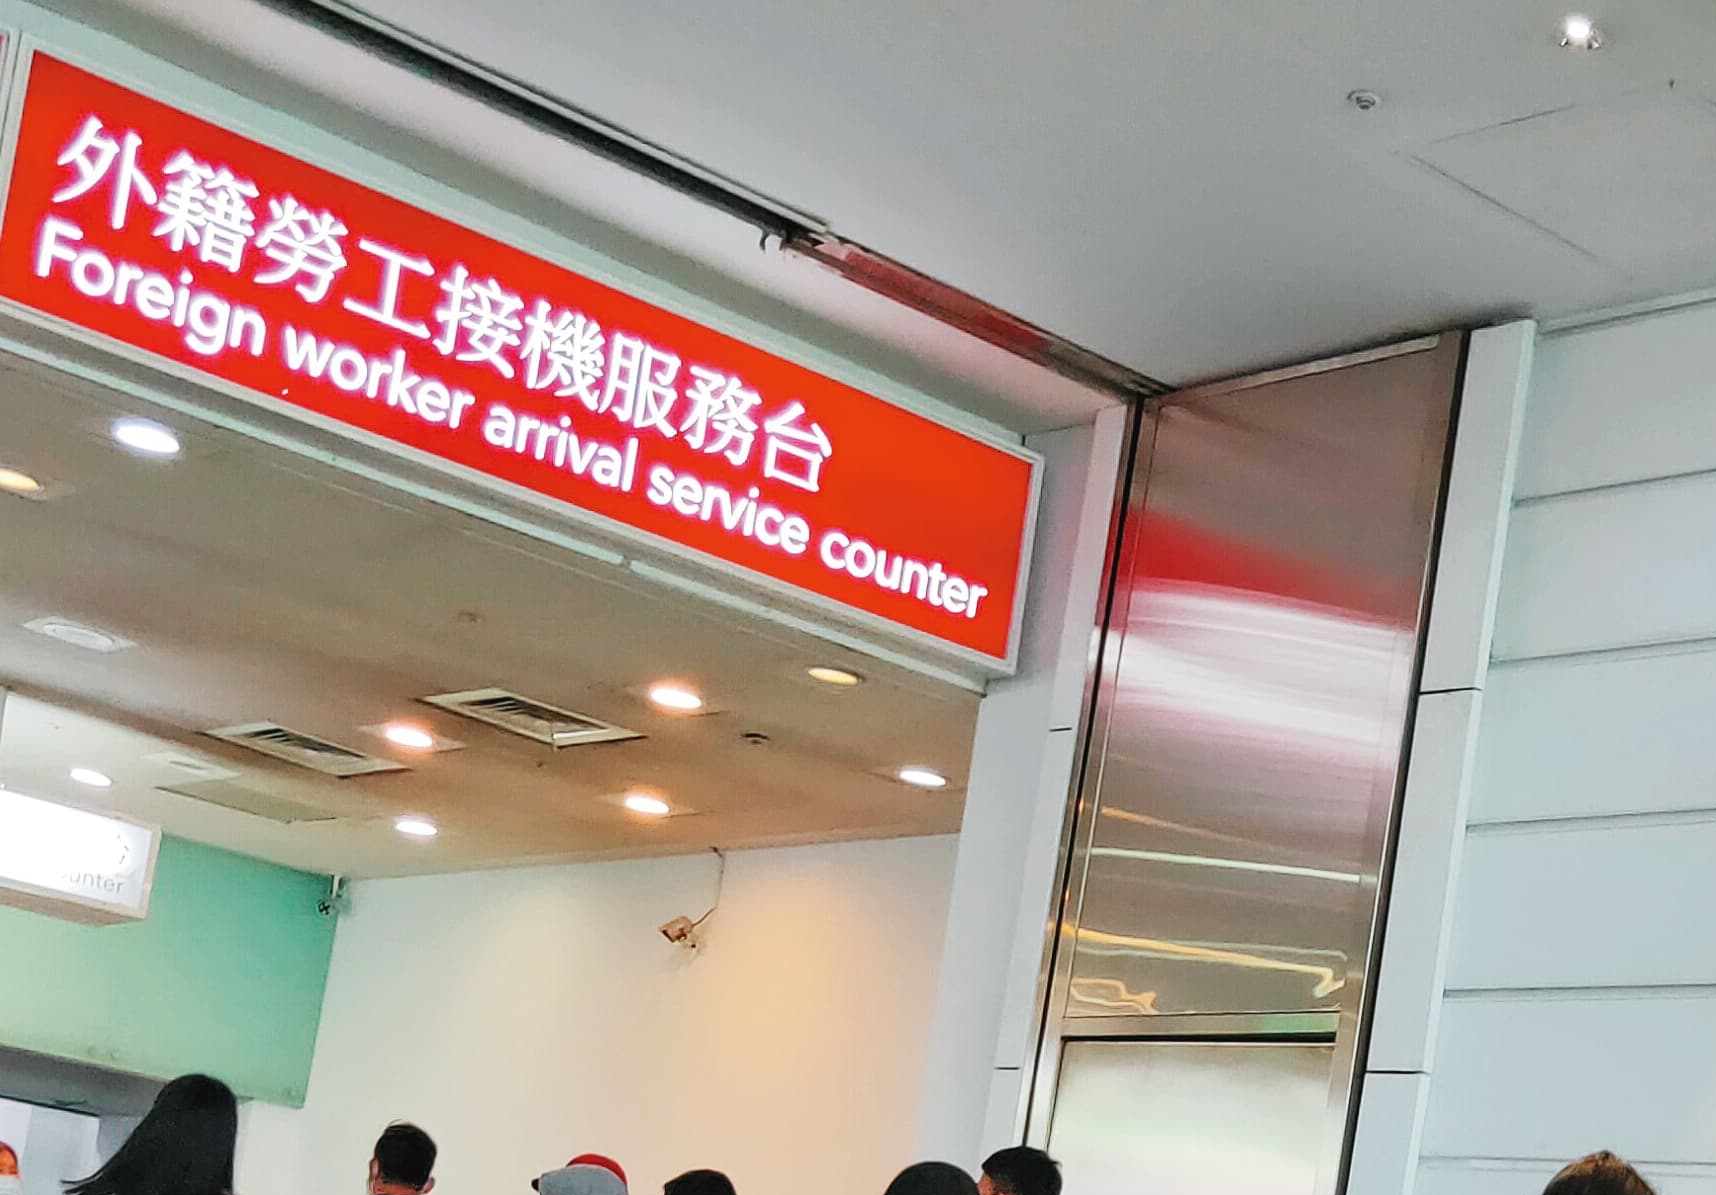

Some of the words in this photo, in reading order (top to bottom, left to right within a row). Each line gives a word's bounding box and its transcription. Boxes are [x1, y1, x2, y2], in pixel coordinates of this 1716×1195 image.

[34, 215, 268, 357] Foreign
[285, 324, 476, 430] worker
[482, 401, 638, 491] arrival
[647, 463, 811, 554] service
[818, 528, 988, 619] counter
[53, 116, 833, 492] 外籍勞工接機服務台
